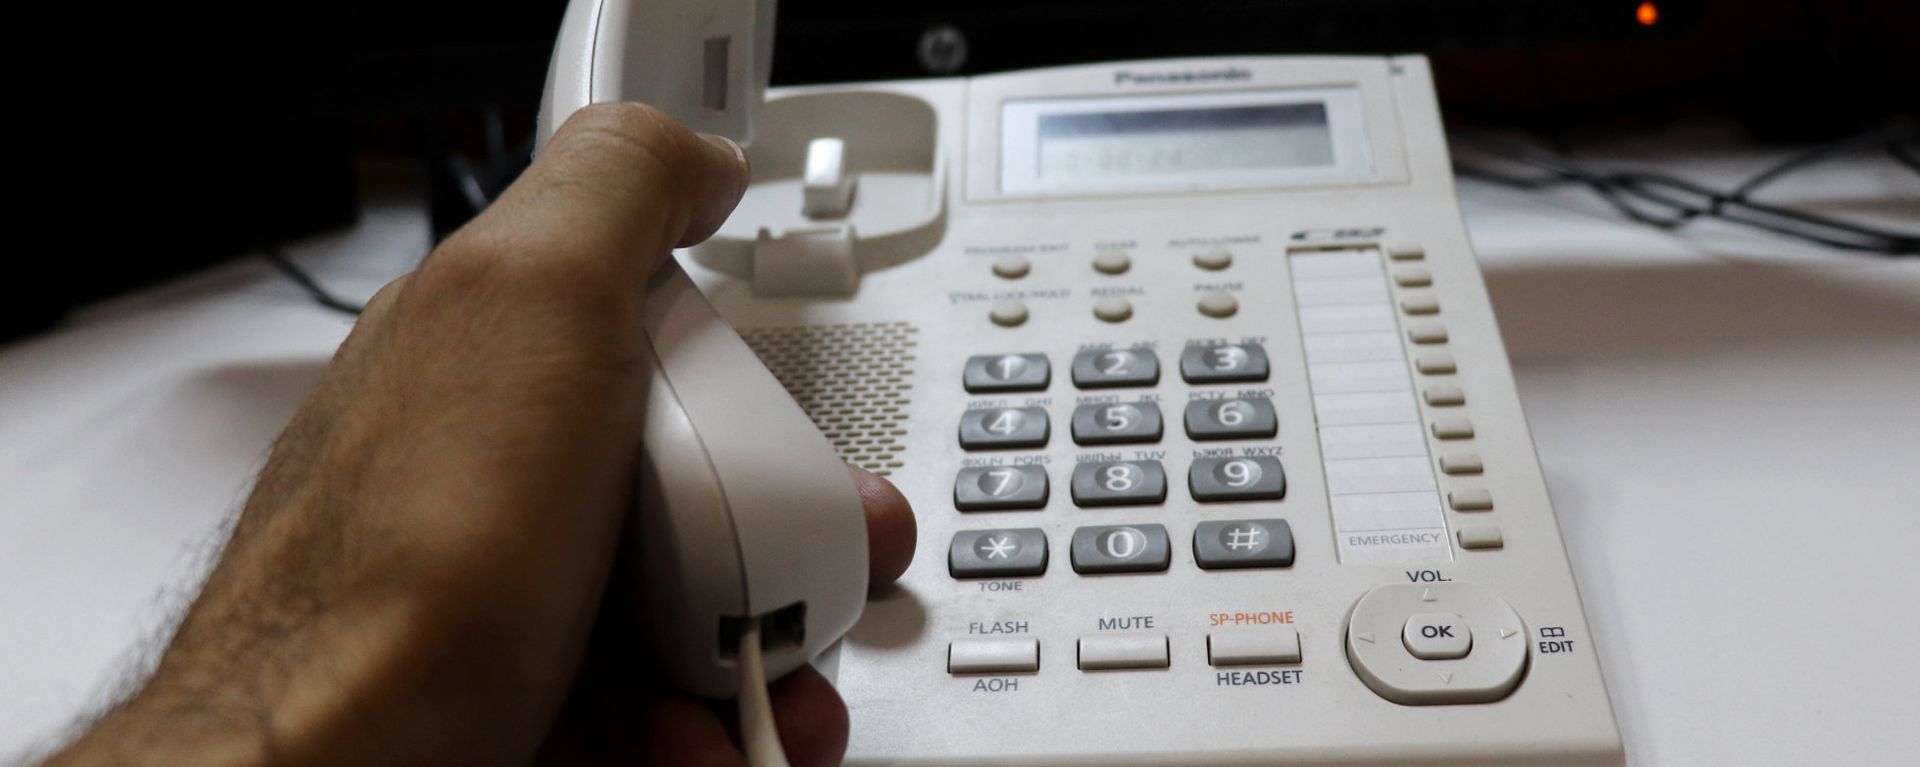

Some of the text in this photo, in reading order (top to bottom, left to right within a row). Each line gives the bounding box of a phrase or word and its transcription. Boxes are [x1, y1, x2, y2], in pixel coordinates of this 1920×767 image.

[1113, 66, 1253, 86] Panasonic
[1094, 240, 1138, 250] CLEAR
[1091, 286, 1146, 298] REDIAL
[1194, 281, 1244, 293] PAUSE
[999, 355, 1012, 380] 1
[1103, 351, 1128, 376] 2
[1213, 347, 1238, 372] 3
[1106, 406, 1130, 431] 5
[1217, 401, 1244, 427] 6
[988, 412, 1017, 436] 4
[1134, 450, 1168, 461] TUV
[1243, 446, 1284, 457] WXYZ
[1014, 455, 1052, 466] PQRS
[1105, 465, 1132, 492] 8
[1223, 461, 1251, 488] 9
[987, 471, 1012, 497] 7
[1106, 529, 1135, 558] 0
[1226, 528, 1262, 551] #
[1349, 532, 1441, 547] EMERGENCY
[1406, 569, 1453, 583] VOL.
[977, 581, 1024, 593] TONE
[1098, 615, 1155, 631] MUTE
[1209, 610, 1295, 627] SP-PHONE
[968, 621, 1030, 635] FLASH
[1421, 624, 1454, 639] OK
[1539, 640, 1575, 654] EDIT
[1216, 669, 1304, 687] HEADSET
